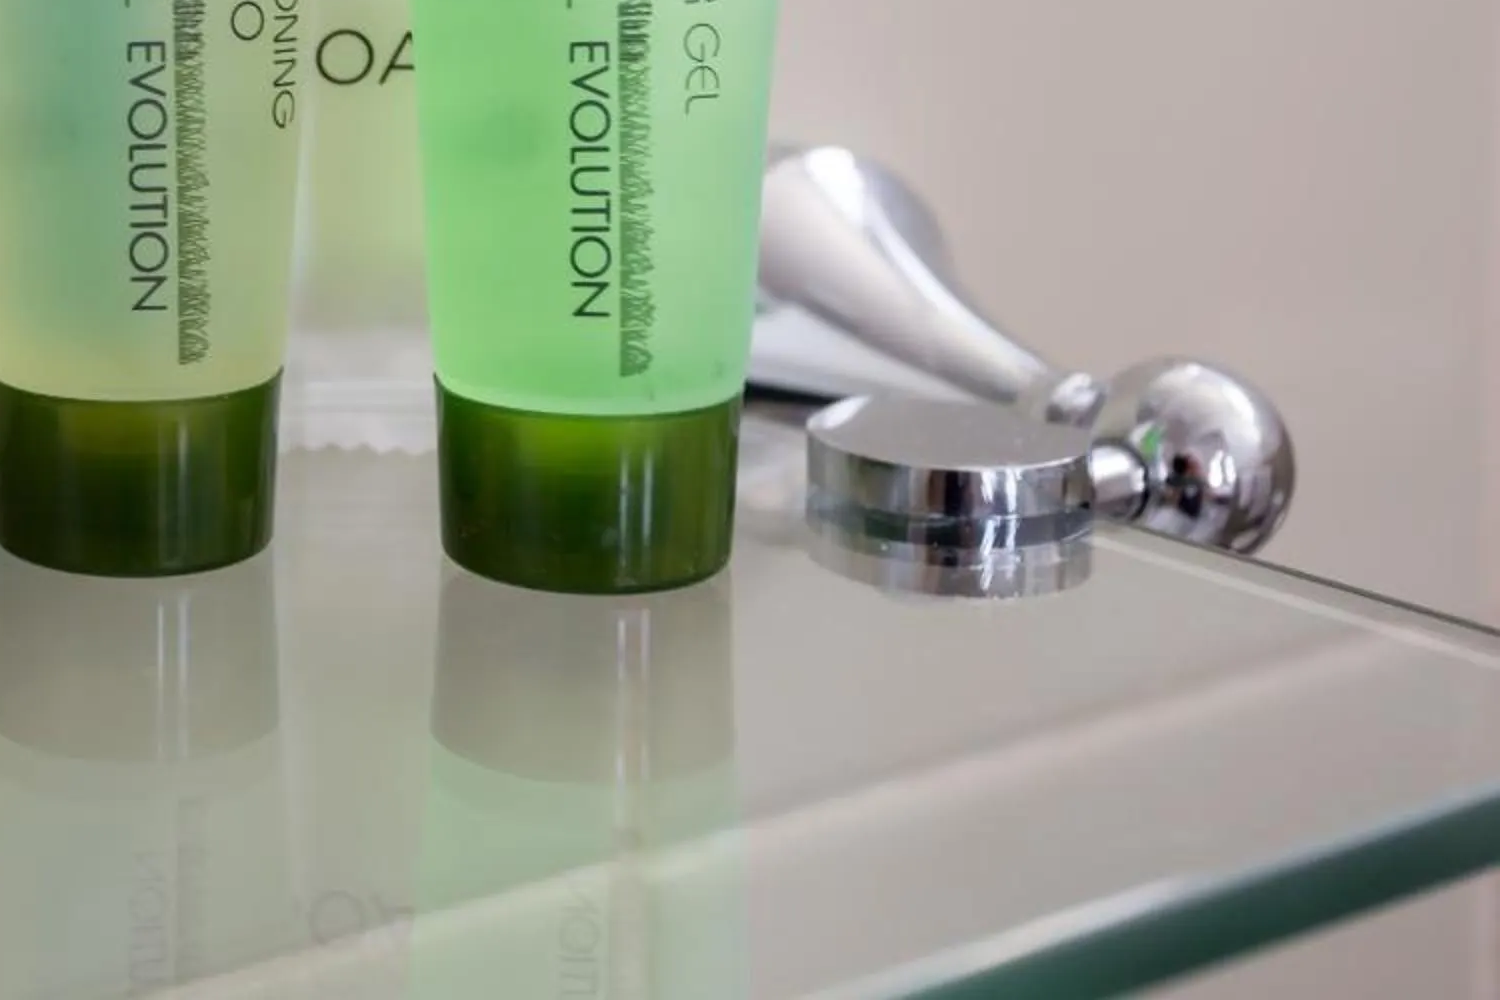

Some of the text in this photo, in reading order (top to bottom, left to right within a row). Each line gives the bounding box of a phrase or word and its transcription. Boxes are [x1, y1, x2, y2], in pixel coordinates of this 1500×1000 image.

[126, 40, 170, 312] EVOLUTION
[568, 40, 612, 318] EVOLUTION
[683, 22, 721, 116] GEL
